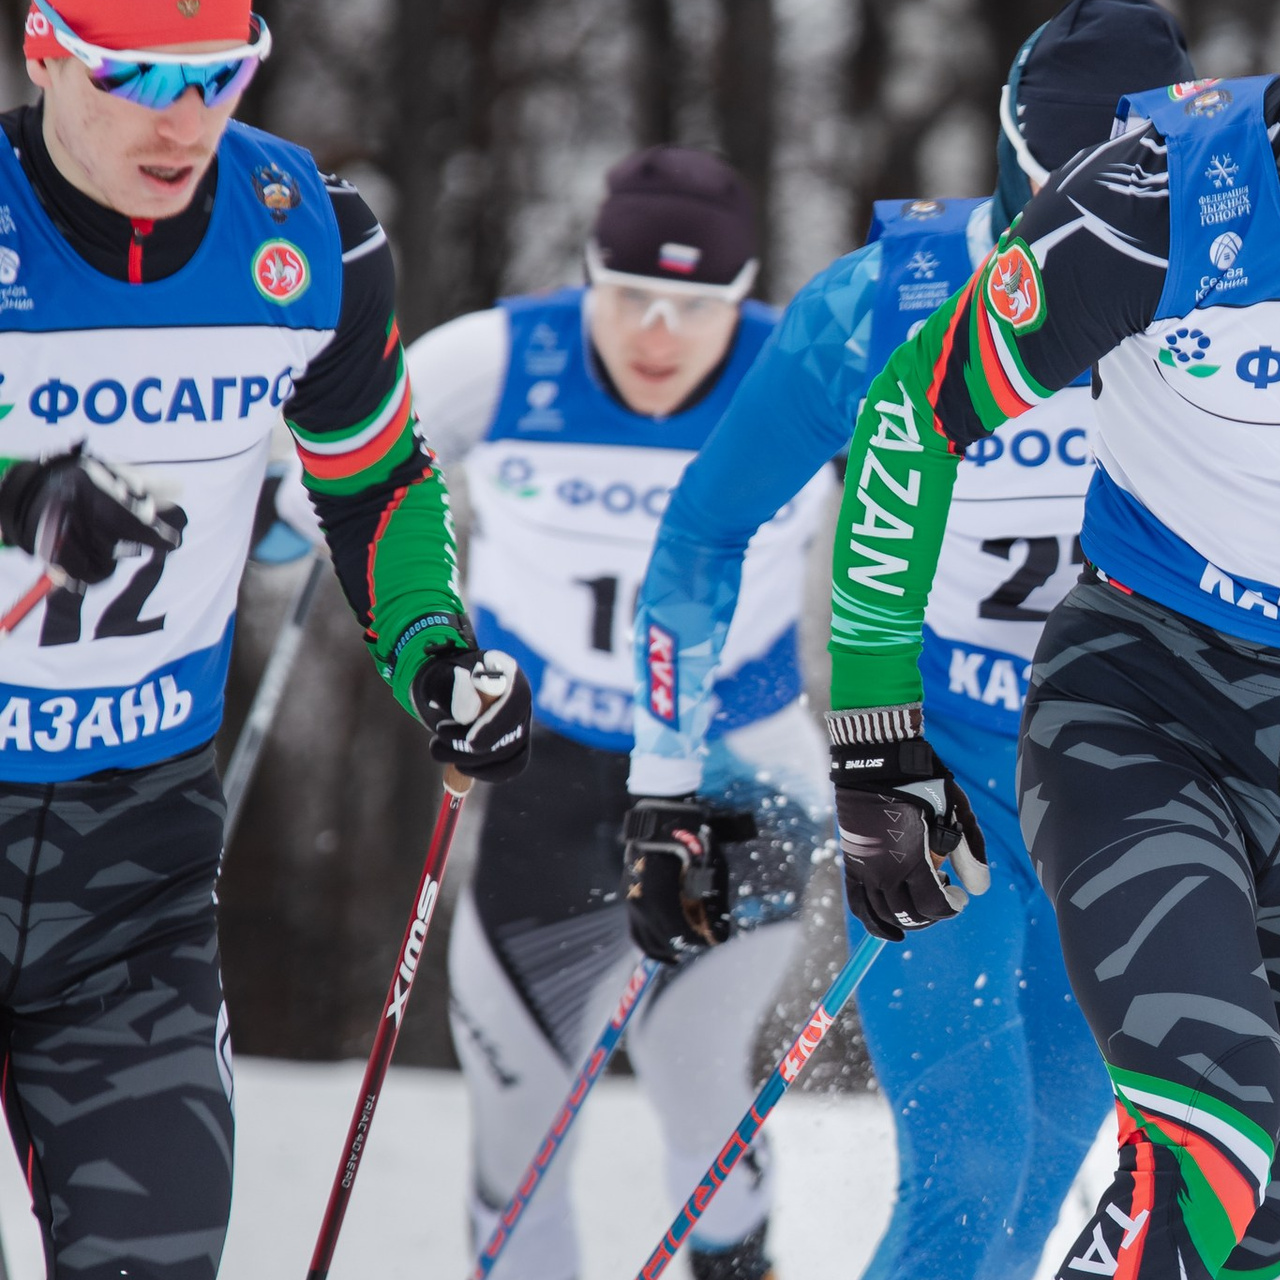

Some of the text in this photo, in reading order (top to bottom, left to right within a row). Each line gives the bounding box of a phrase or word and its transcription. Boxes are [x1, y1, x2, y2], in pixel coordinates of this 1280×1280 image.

[1199, 185, 1249, 205] ФЕДЕРАЦИЯ
[1200, 194, 1250, 216] ЛЫЖНЫХ
[965, 428, 1096, 467] ФОС
[847, 380, 925, 597] TAZAN
[0, 675, 192, 752] АЗАНЬ
